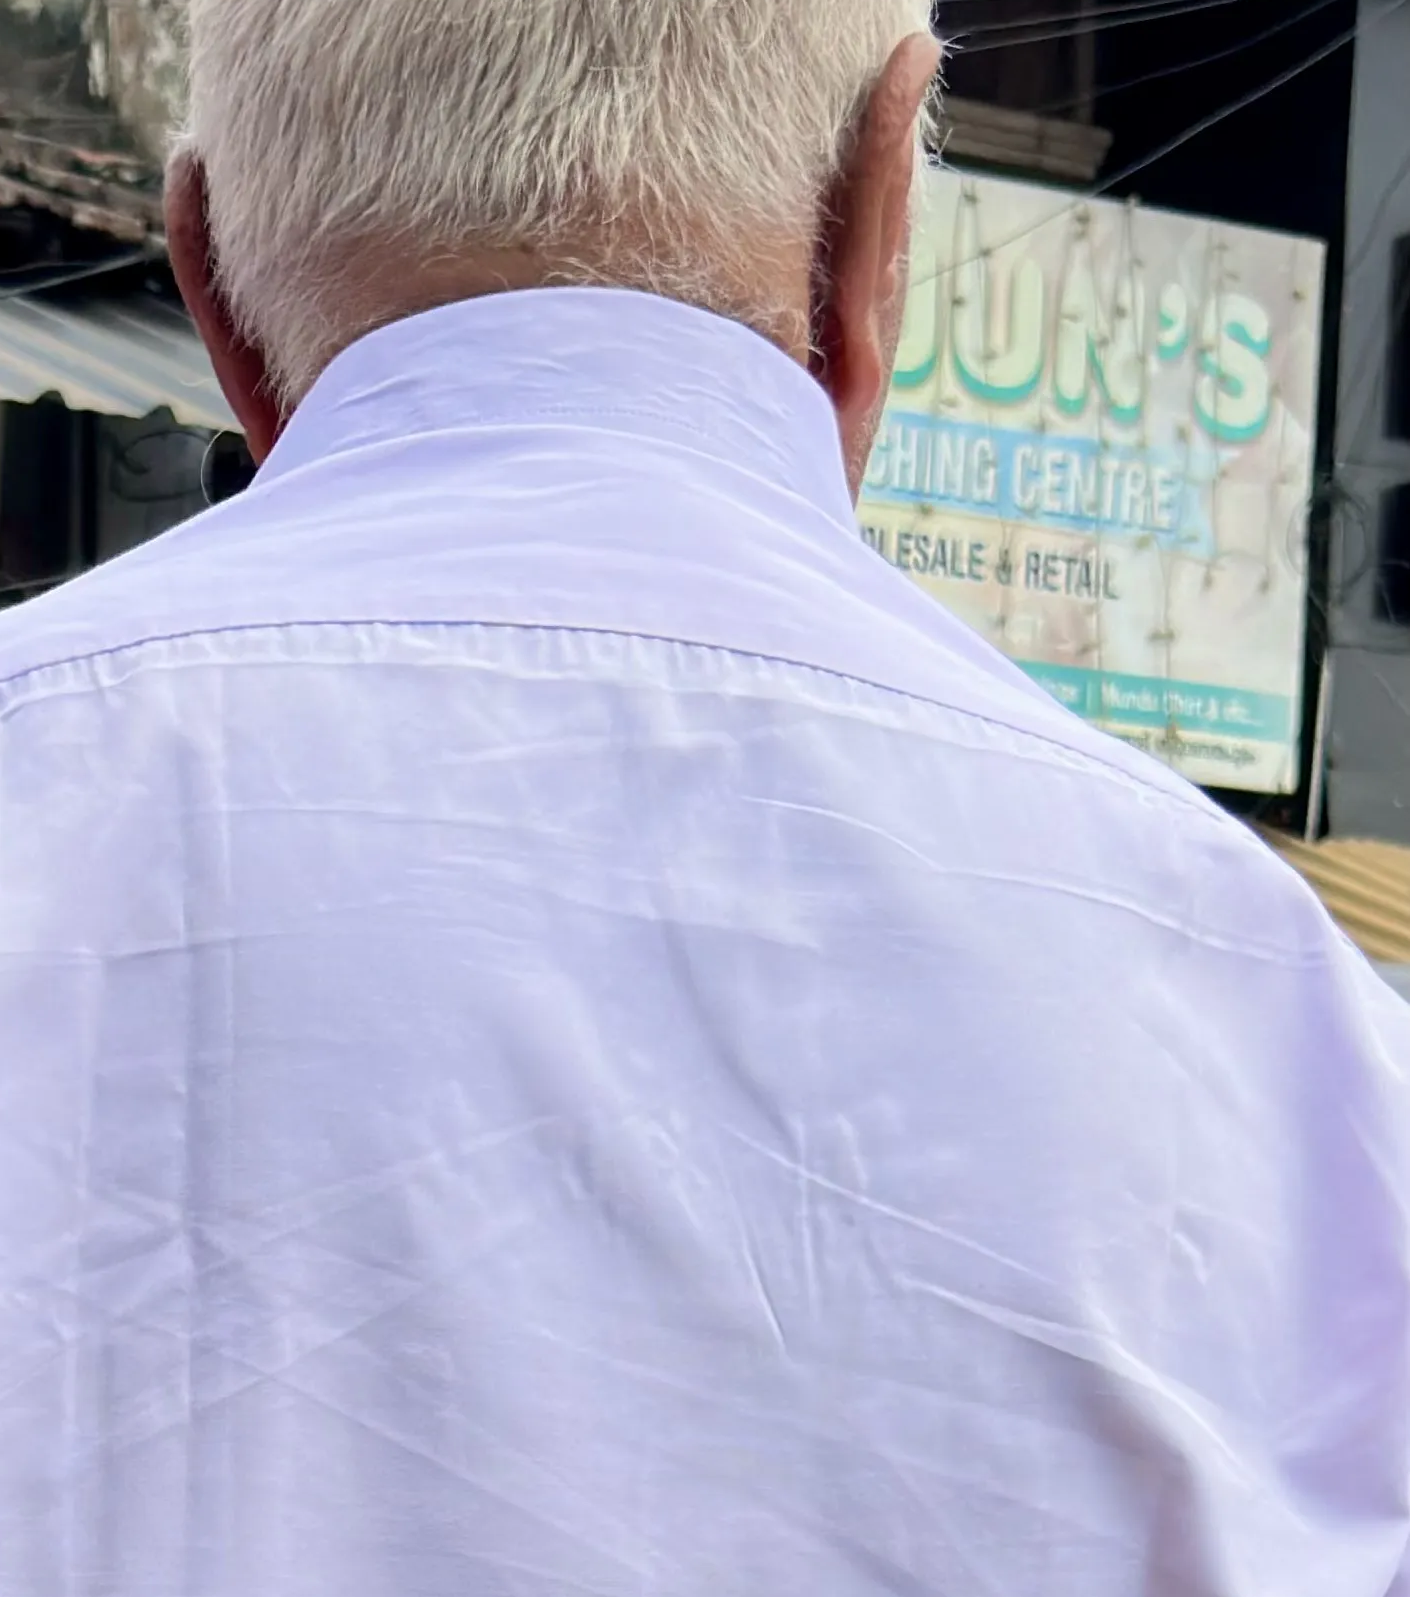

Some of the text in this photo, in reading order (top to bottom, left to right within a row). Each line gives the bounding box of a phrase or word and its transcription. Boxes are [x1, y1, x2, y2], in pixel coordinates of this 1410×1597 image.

[1013, 444, 1178, 530] CENTRE
[995, 549, 1013, 588] &
[1025, 550, 1121, 601] RETAIL
